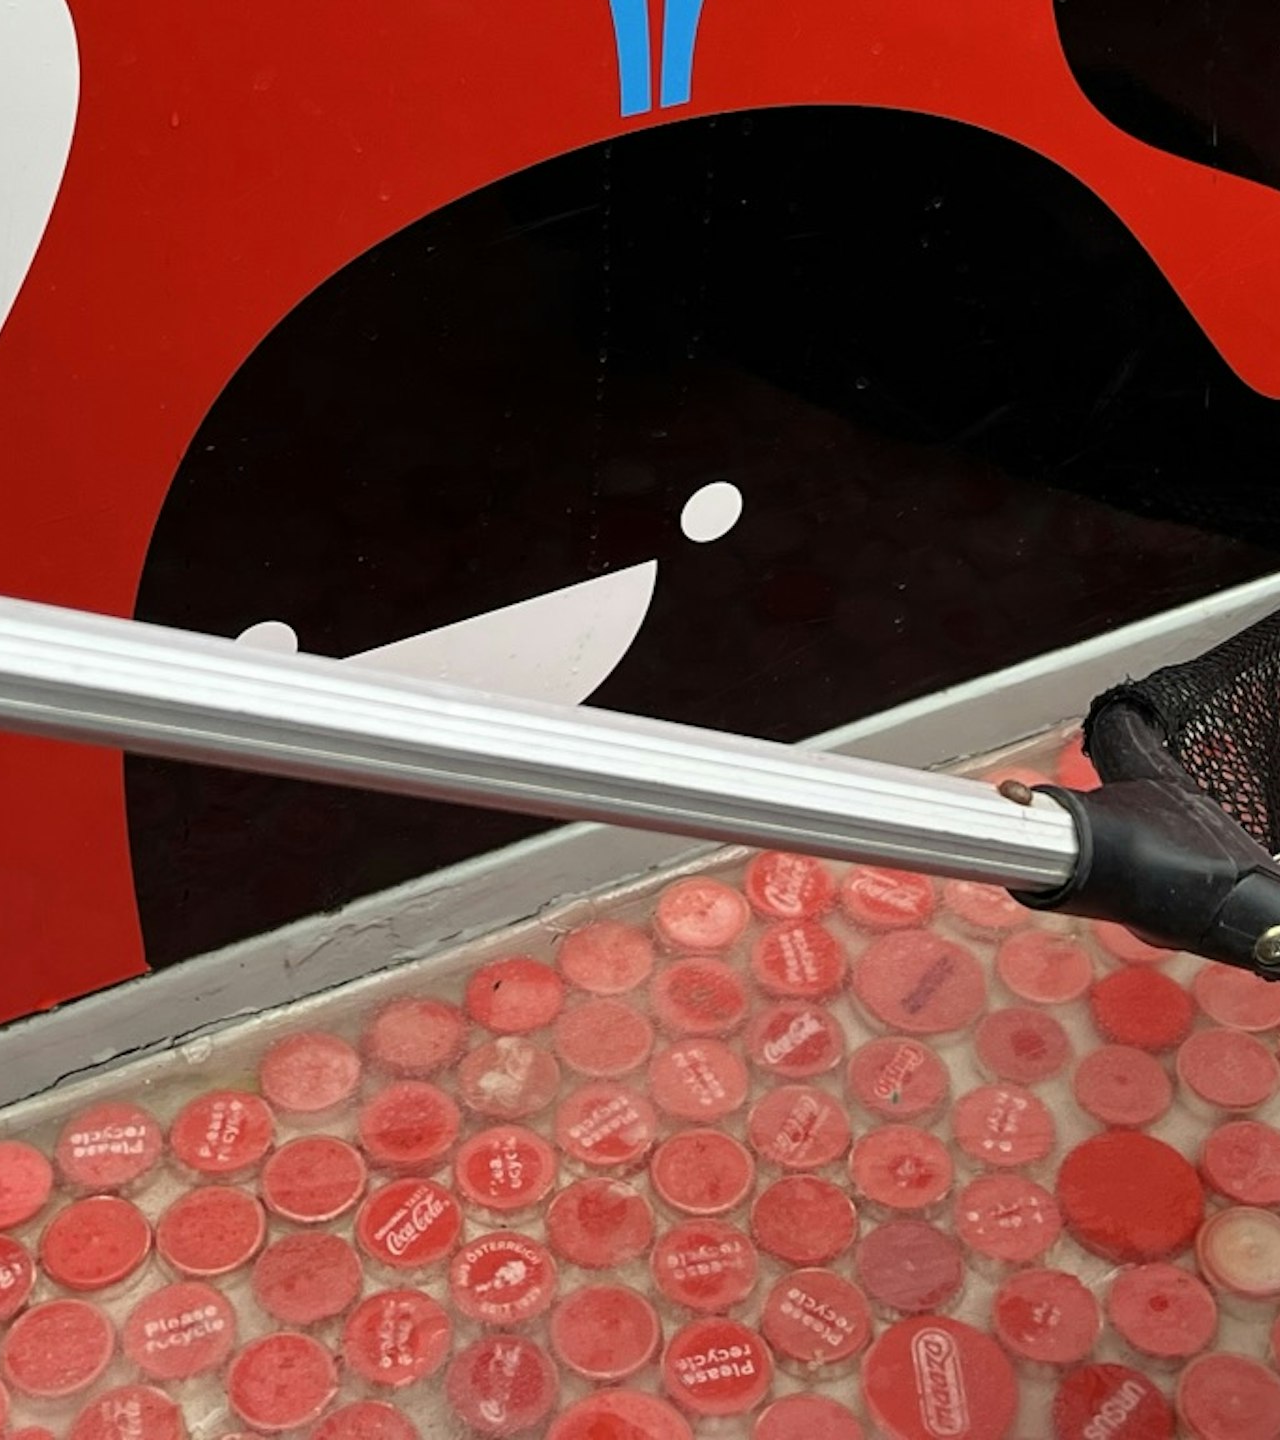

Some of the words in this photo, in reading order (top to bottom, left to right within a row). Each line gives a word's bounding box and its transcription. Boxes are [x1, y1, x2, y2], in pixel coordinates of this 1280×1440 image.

[70, 1126, 145, 1144] recycle
[73, 1140, 142, 1157] Please
[467, 1238, 542, 1265] ÖSTERREICH
[144, 1305, 216, 1335] Please
[780, 1301, 842, 1345] Please
[787, 1287, 854, 1333] recycle
[675, 1344, 750, 1370] recycle
[683, 1360, 753, 1384] Please
[922, 1337, 956, 1430] maaza
